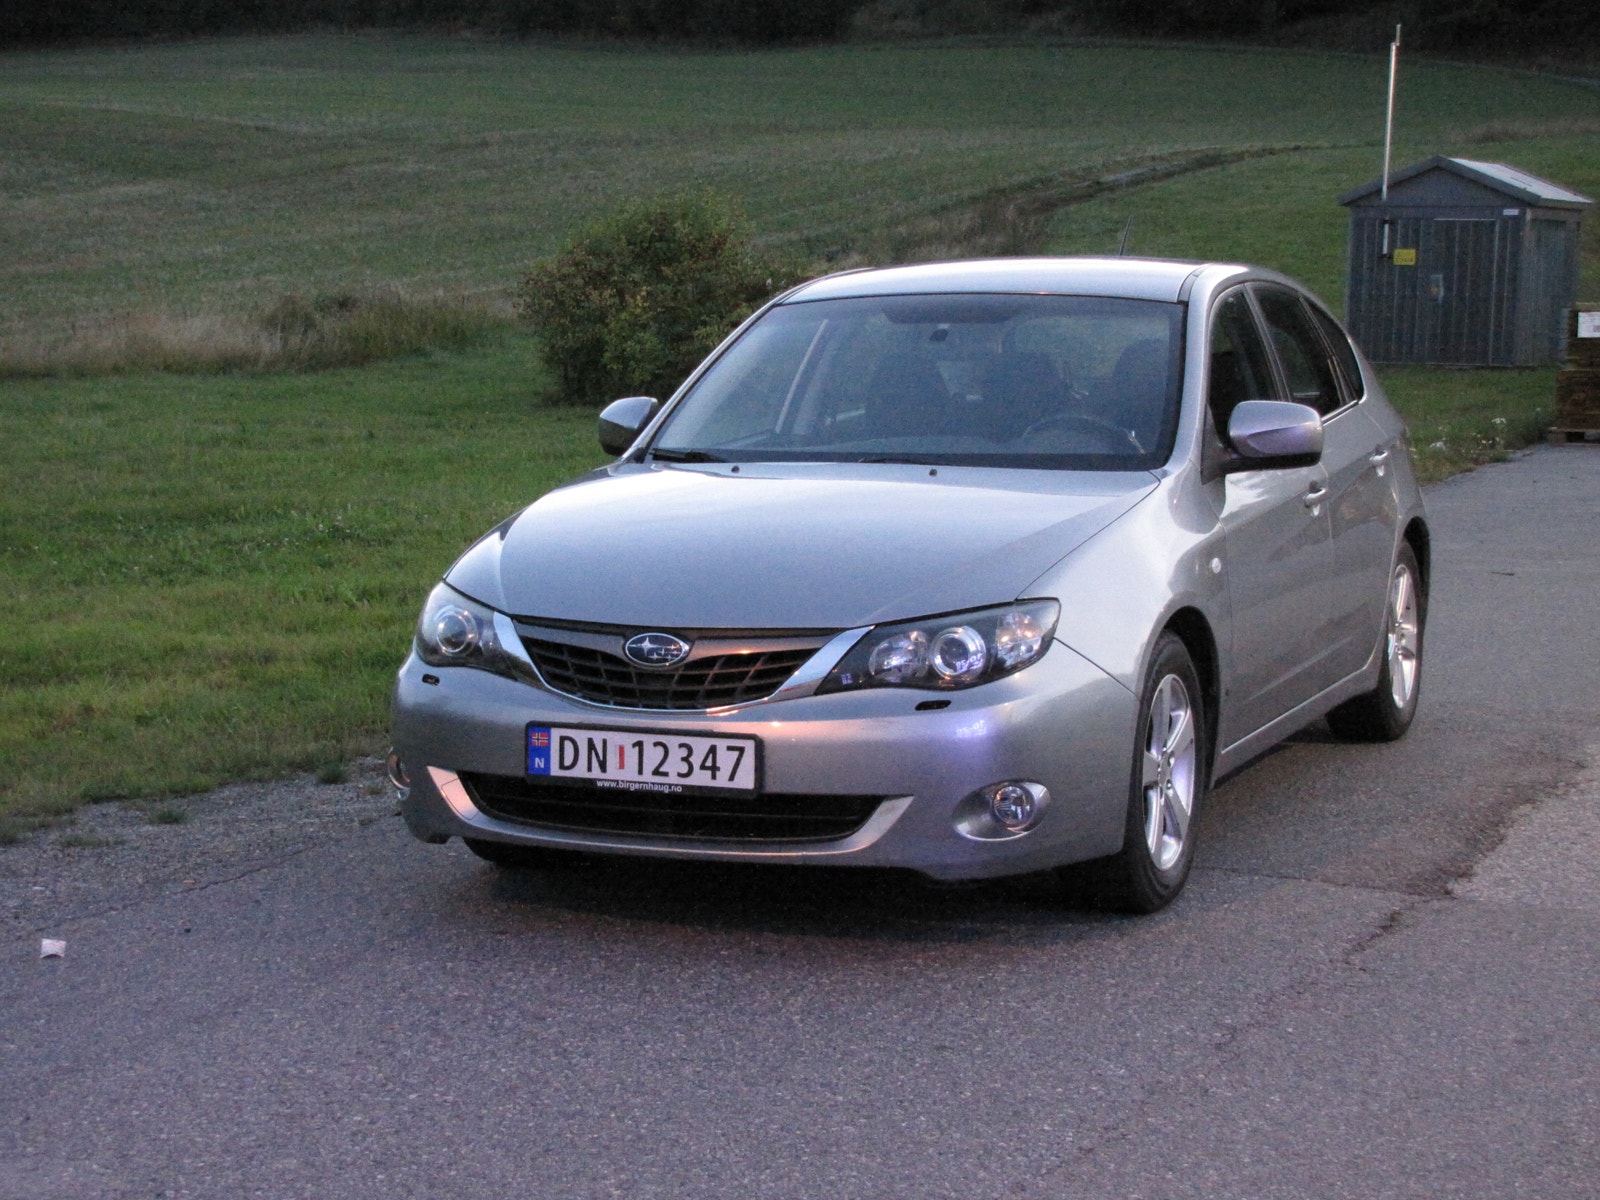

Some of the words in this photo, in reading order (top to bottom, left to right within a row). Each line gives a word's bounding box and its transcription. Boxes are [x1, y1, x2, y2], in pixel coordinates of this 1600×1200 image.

[534, 757, 545, 769] N
[558, 735, 608, 773] DN
[632, 740, 746, 782] 12347
[596, 780, 683, 793] www.birgernhaug.no
